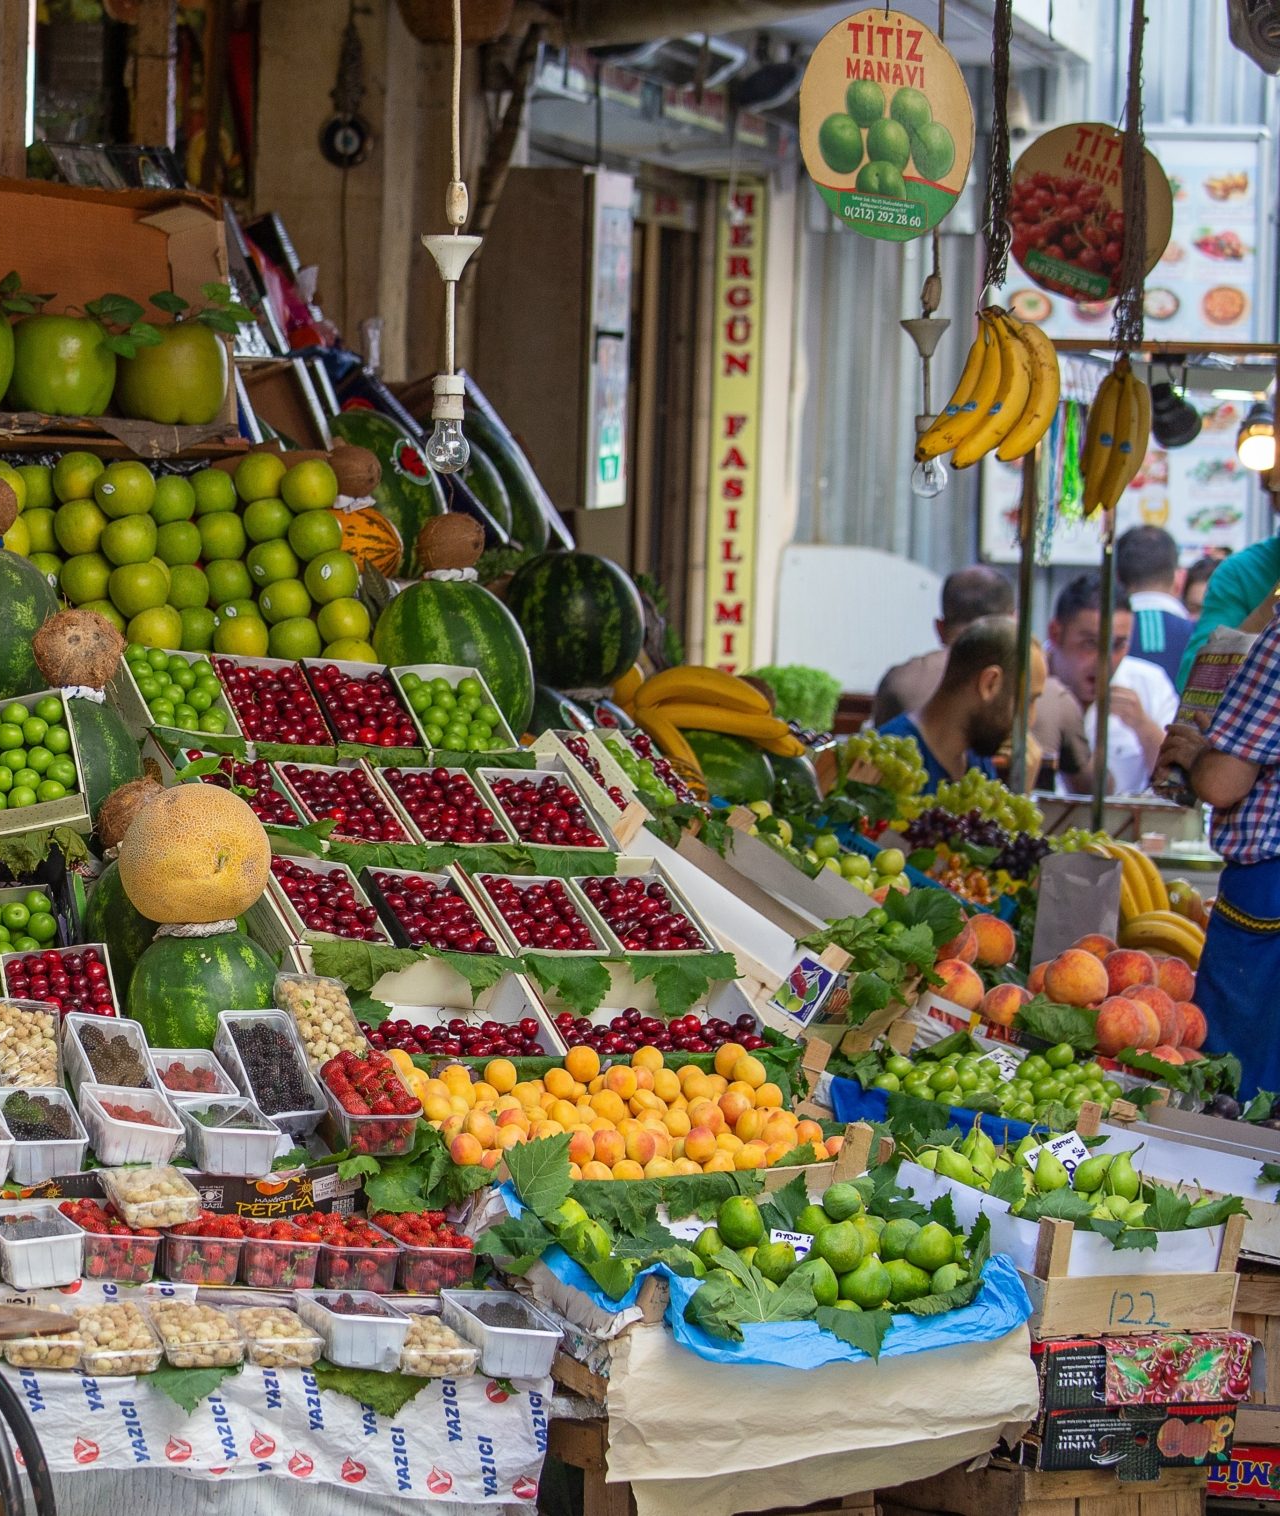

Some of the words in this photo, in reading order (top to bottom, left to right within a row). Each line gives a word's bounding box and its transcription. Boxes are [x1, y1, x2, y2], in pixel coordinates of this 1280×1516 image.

[847, 15, 923, 62] TİTİZ
[846, 57, 925, 89] MANAVI
[1064, 152, 1118, 187] MANA
[1076, 127, 1124, 167] TİT
[844, 206, 874, 222] 0(212)
[877, 211, 894, 223] 292
[896, 214, 908, 226] 28
[909, 216, 921, 228] 60
[235, 1195, 315, 1217] PEPITA
[1108, 1288, 1171, 1328] 122
[19, 1368, 46, 1413] YAZI
[262, 1366, 282, 1409] YAZI
[442, 1378, 463, 1442] YAZICI
[119, 1400, 151, 1463] YAZICI
[207, 1397, 239, 1460] YAZICI
[529, 1390, 549, 1453] YAZICI
[390, 1427, 413, 1492] YAZICI
[477, 1435, 498, 1497] YAZICI
